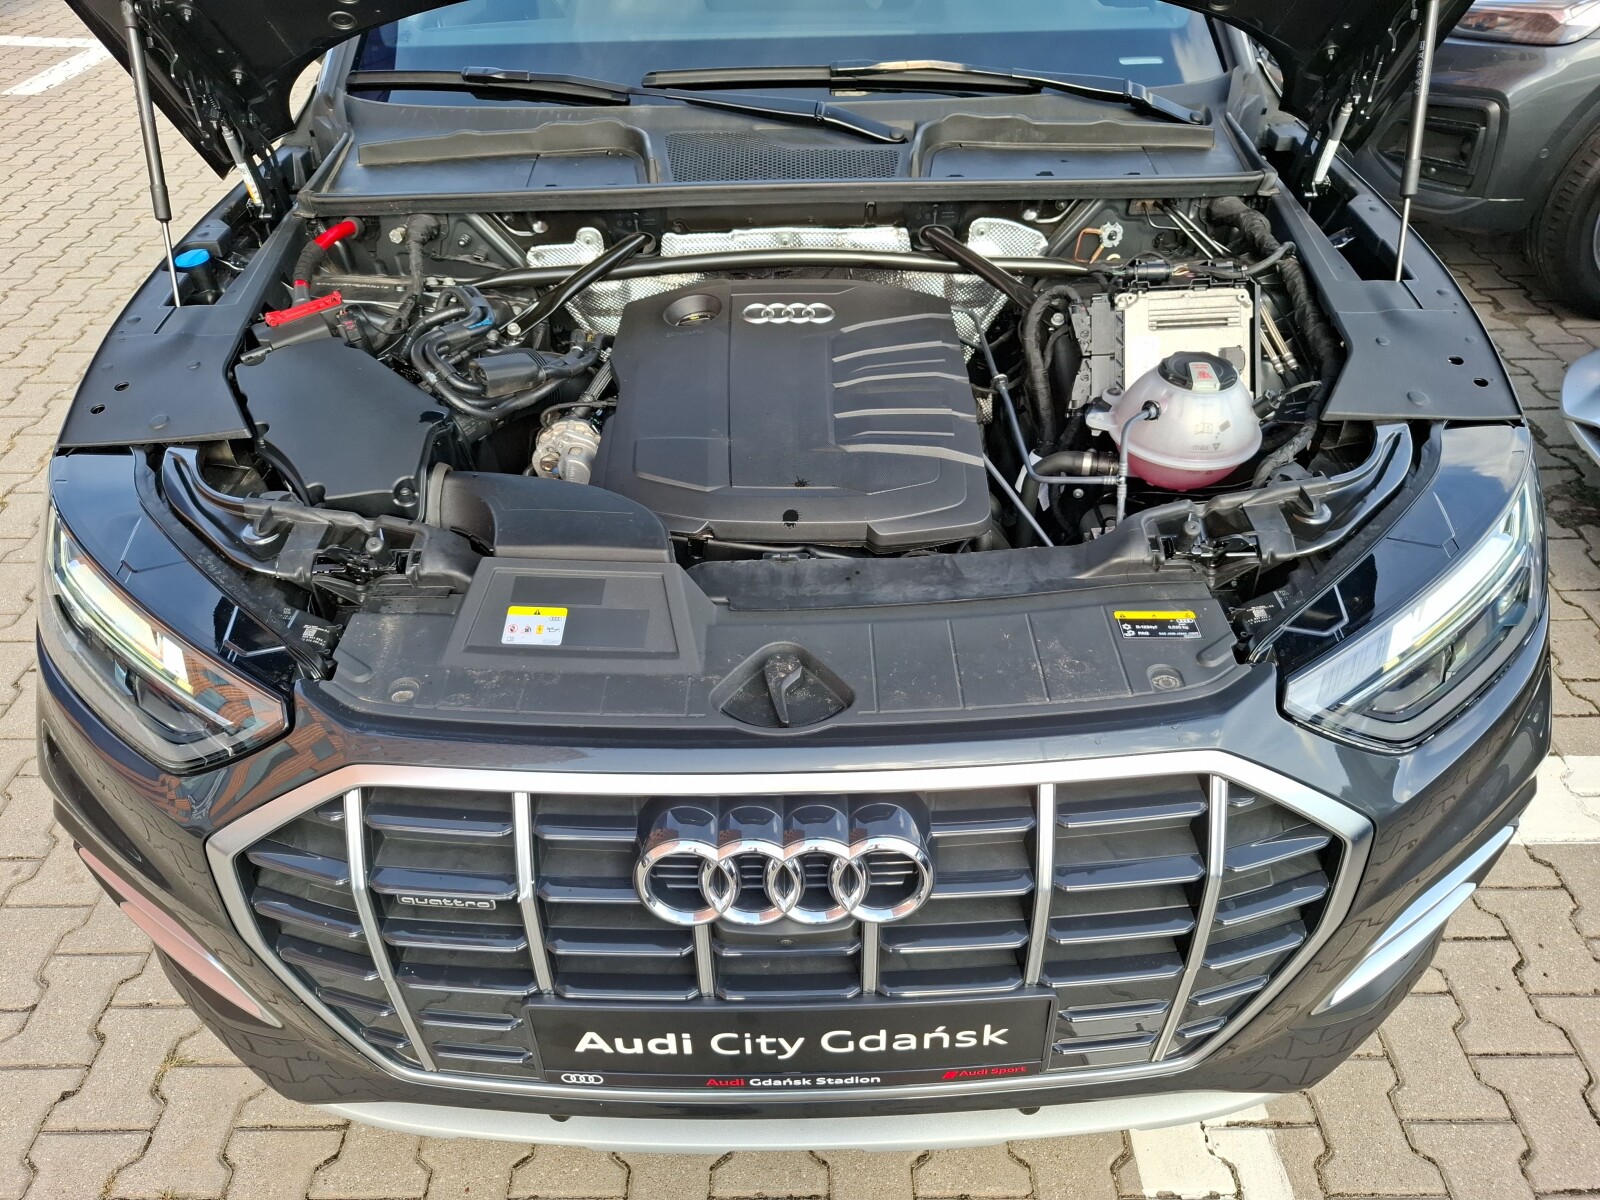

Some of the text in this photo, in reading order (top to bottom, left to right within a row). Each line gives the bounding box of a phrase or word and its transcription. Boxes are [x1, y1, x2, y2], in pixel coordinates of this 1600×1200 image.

[401, 896, 491, 908] quattro
[574, 1023, 1009, 1060] Audi City Gdańsk
[958, 1065, 1027, 1077] Audi Sport
[705, 1075, 881, 1087] Audi Gdańsk Stadion
